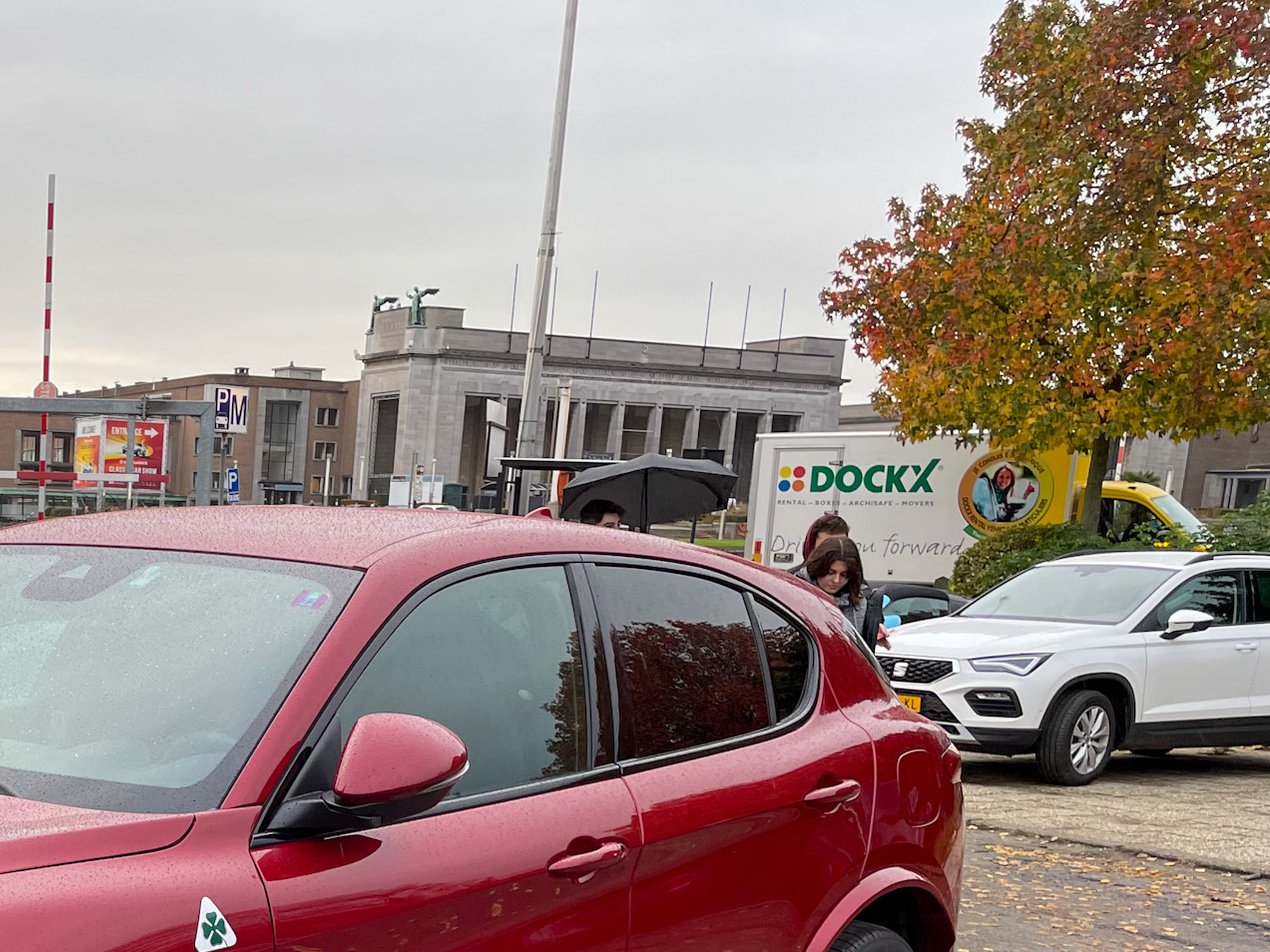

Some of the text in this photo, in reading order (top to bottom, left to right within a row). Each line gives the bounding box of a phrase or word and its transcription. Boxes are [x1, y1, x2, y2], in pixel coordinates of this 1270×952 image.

[216, 388, 247, 425] P M
[111, 427, 143, 435] ENTRCE
[229, 472, 238, 489] P
[810, 459, 941, 493] DOCKX
